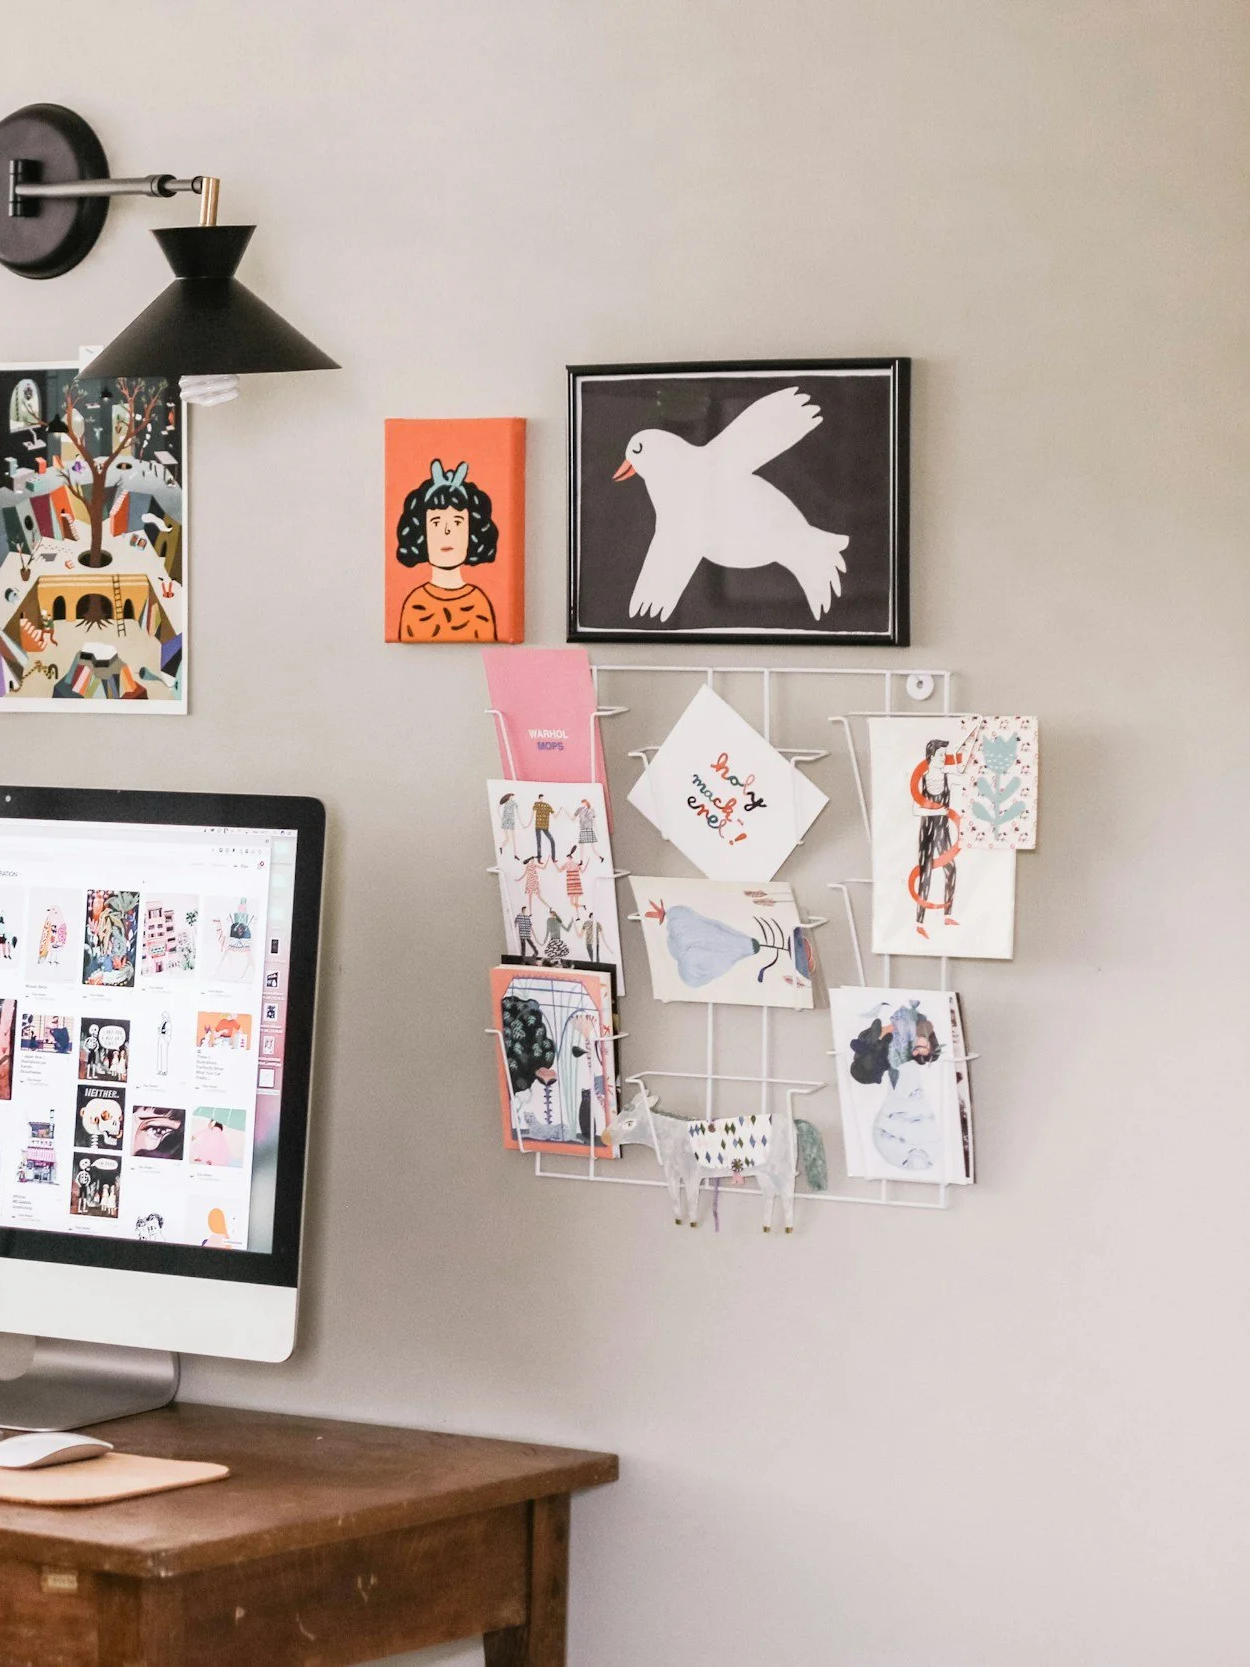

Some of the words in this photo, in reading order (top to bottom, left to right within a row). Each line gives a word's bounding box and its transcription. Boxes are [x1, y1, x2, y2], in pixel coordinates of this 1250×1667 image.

[528, 729, 569, 739] WARHOL
[537, 741, 564, 751] MOPS
[710, 752, 767, 812] holy
